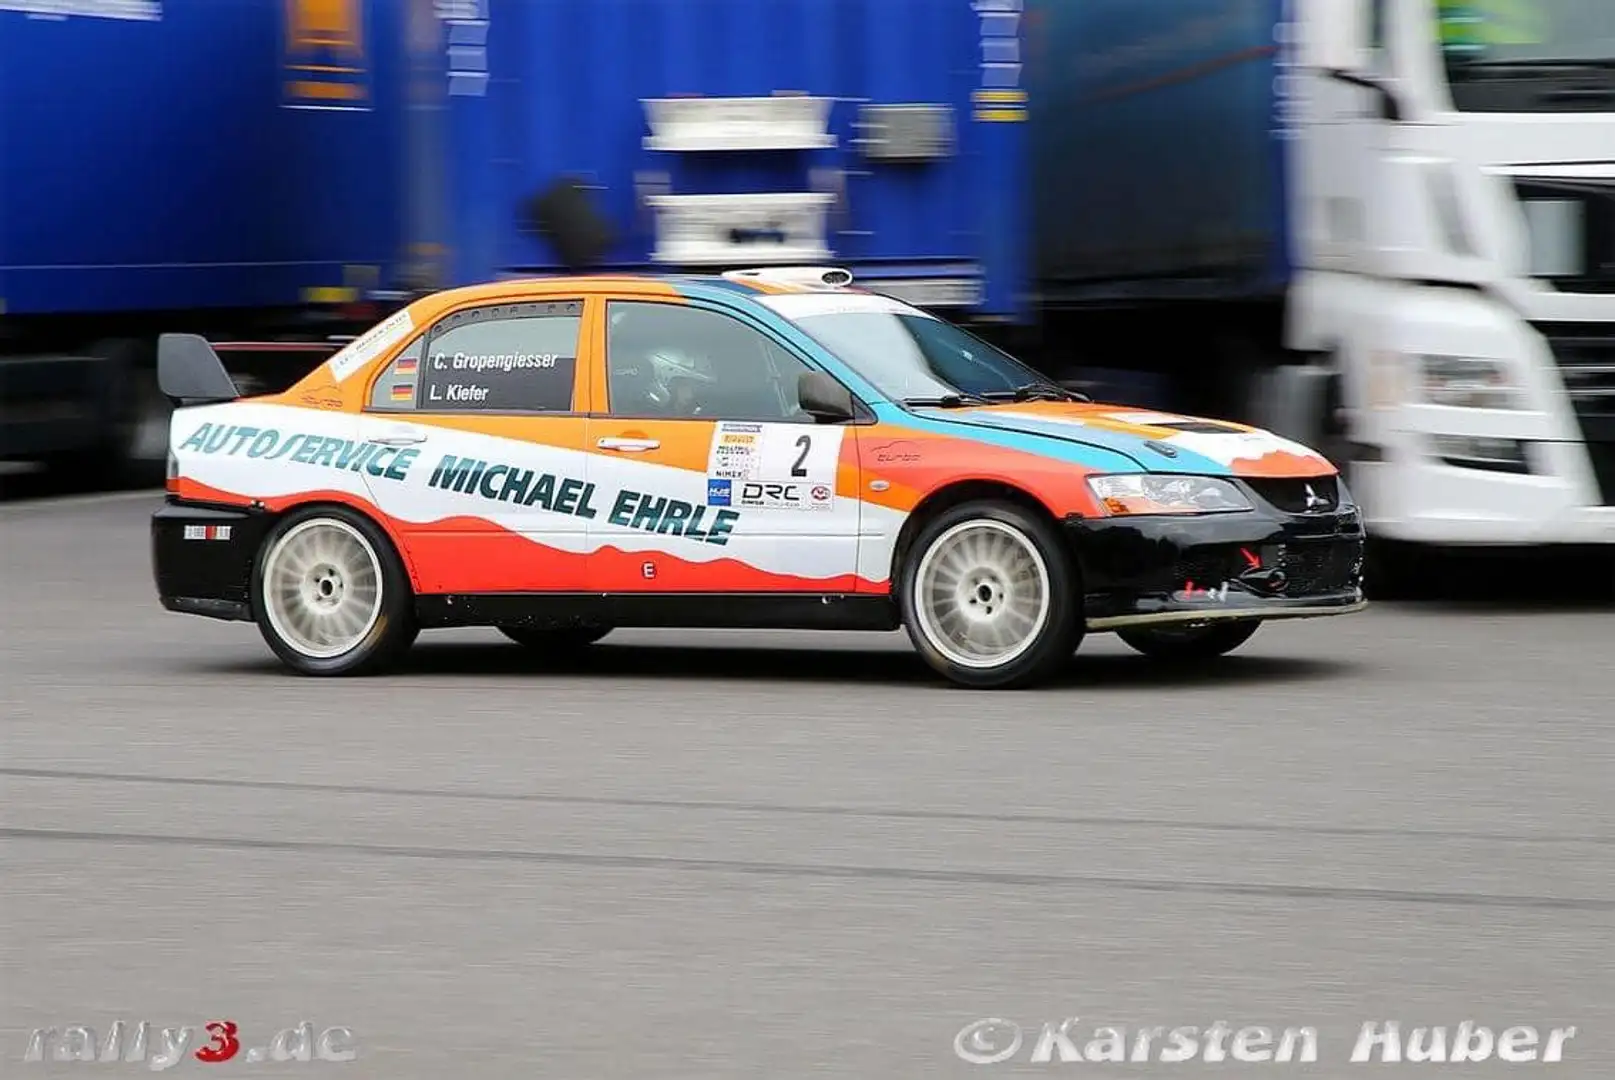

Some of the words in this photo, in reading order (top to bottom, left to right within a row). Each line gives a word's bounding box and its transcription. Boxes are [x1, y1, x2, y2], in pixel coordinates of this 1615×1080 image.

[434, 352, 448, 370] C.
[453, 351, 559, 372] Gropengiesser
[429, 384, 443, 401] L.
[446, 384, 490, 401] Kiefer
[791, 434, 812, 477] 2
[178, 422, 421, 482] AUTOSERVICE
[428, 454, 598, 520] MICHAEL
[607, 489, 740, 546] EHRLE
[742, 482, 800, 501] DRC
[642, 562, 656, 578] E
